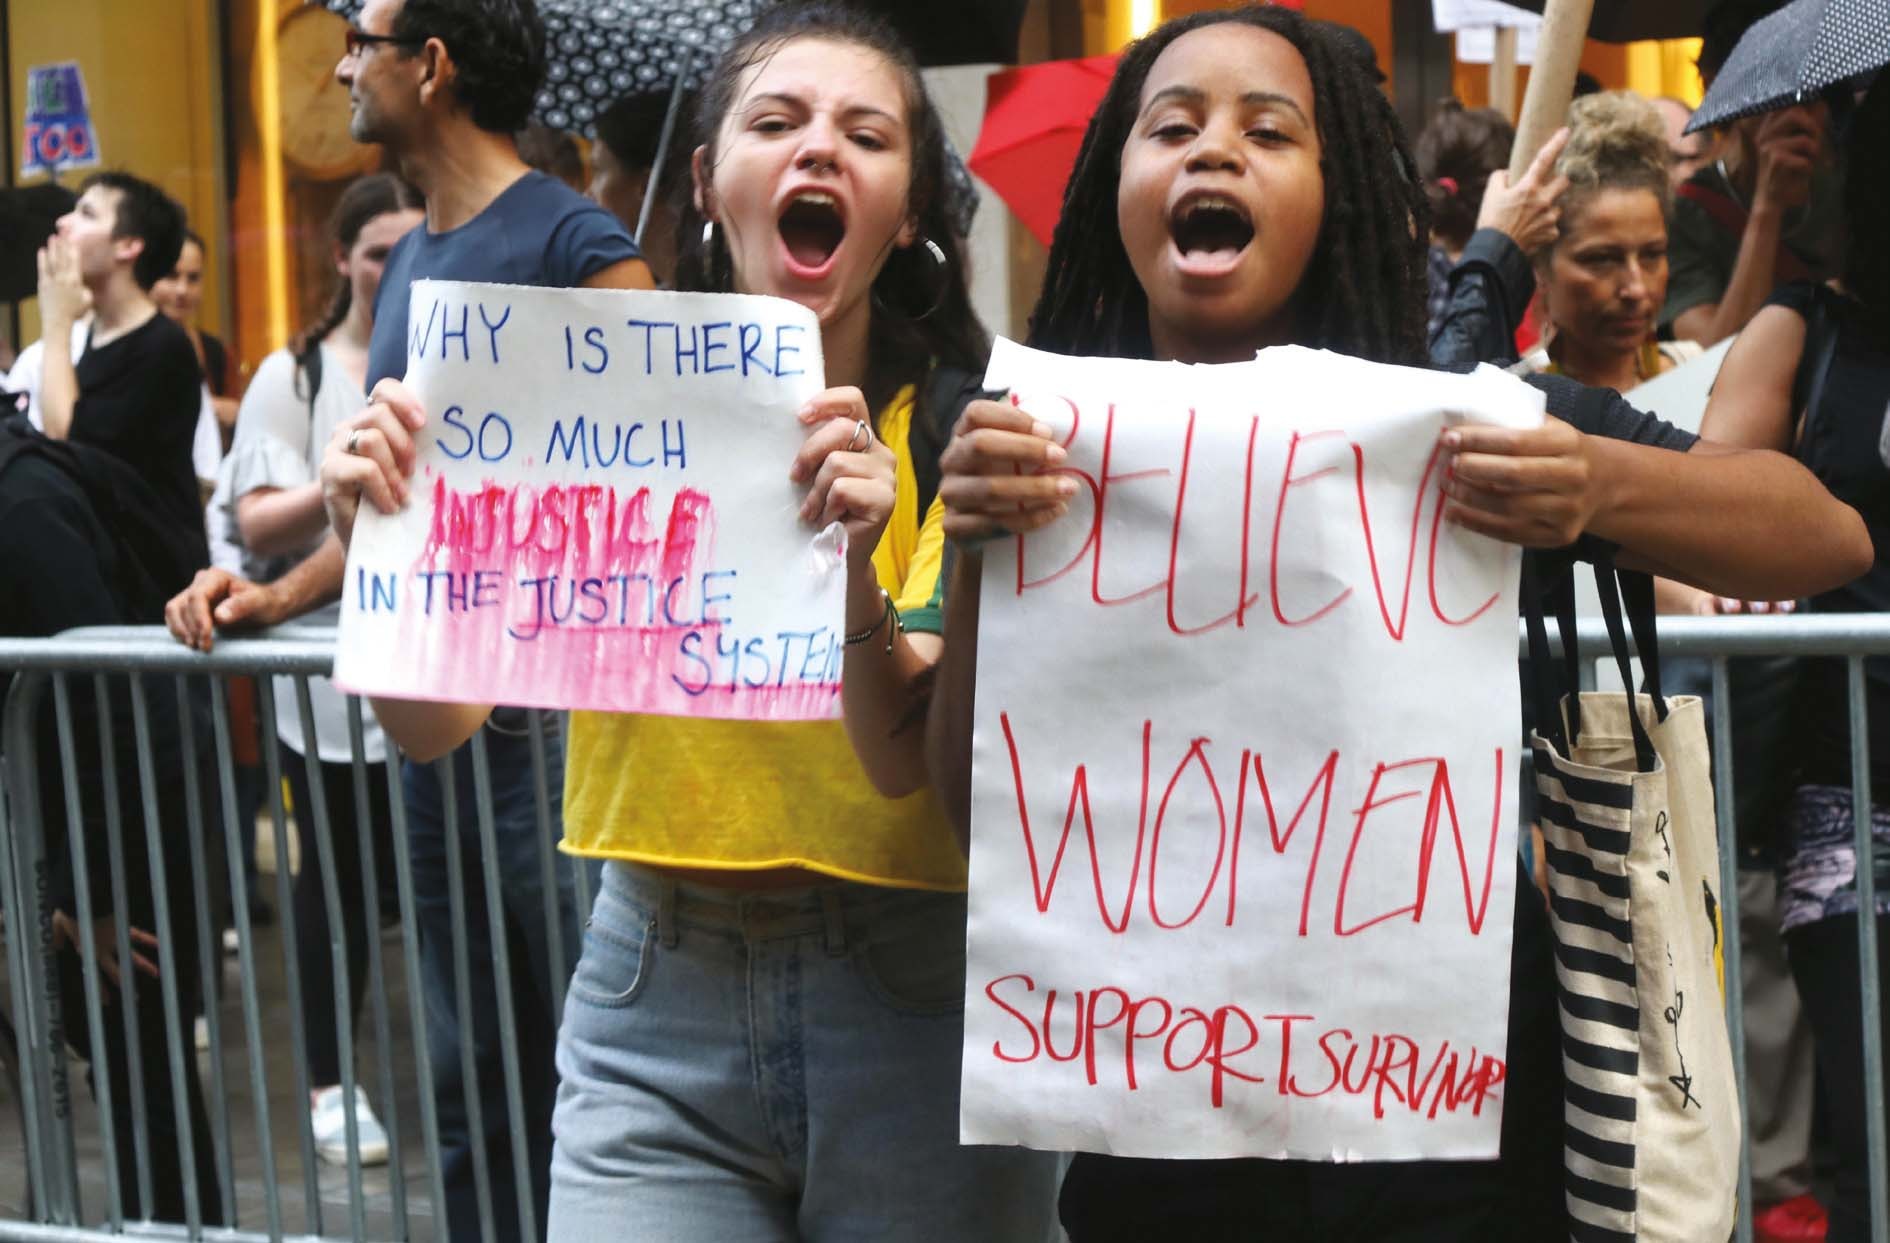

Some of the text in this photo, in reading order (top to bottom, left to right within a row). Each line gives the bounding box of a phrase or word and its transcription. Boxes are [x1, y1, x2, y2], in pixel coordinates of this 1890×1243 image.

[409, 298, 806, 377] WHY IS THERE
[436, 405, 687, 471] SO MUCH
[428, 475, 712, 556] INJUSTICE
[357, 567, 738, 641] IN THE JUSTICE
[1000, 712, 1503, 936] WOMEN
[985, 974, 1315, 1107] SUPPORT
